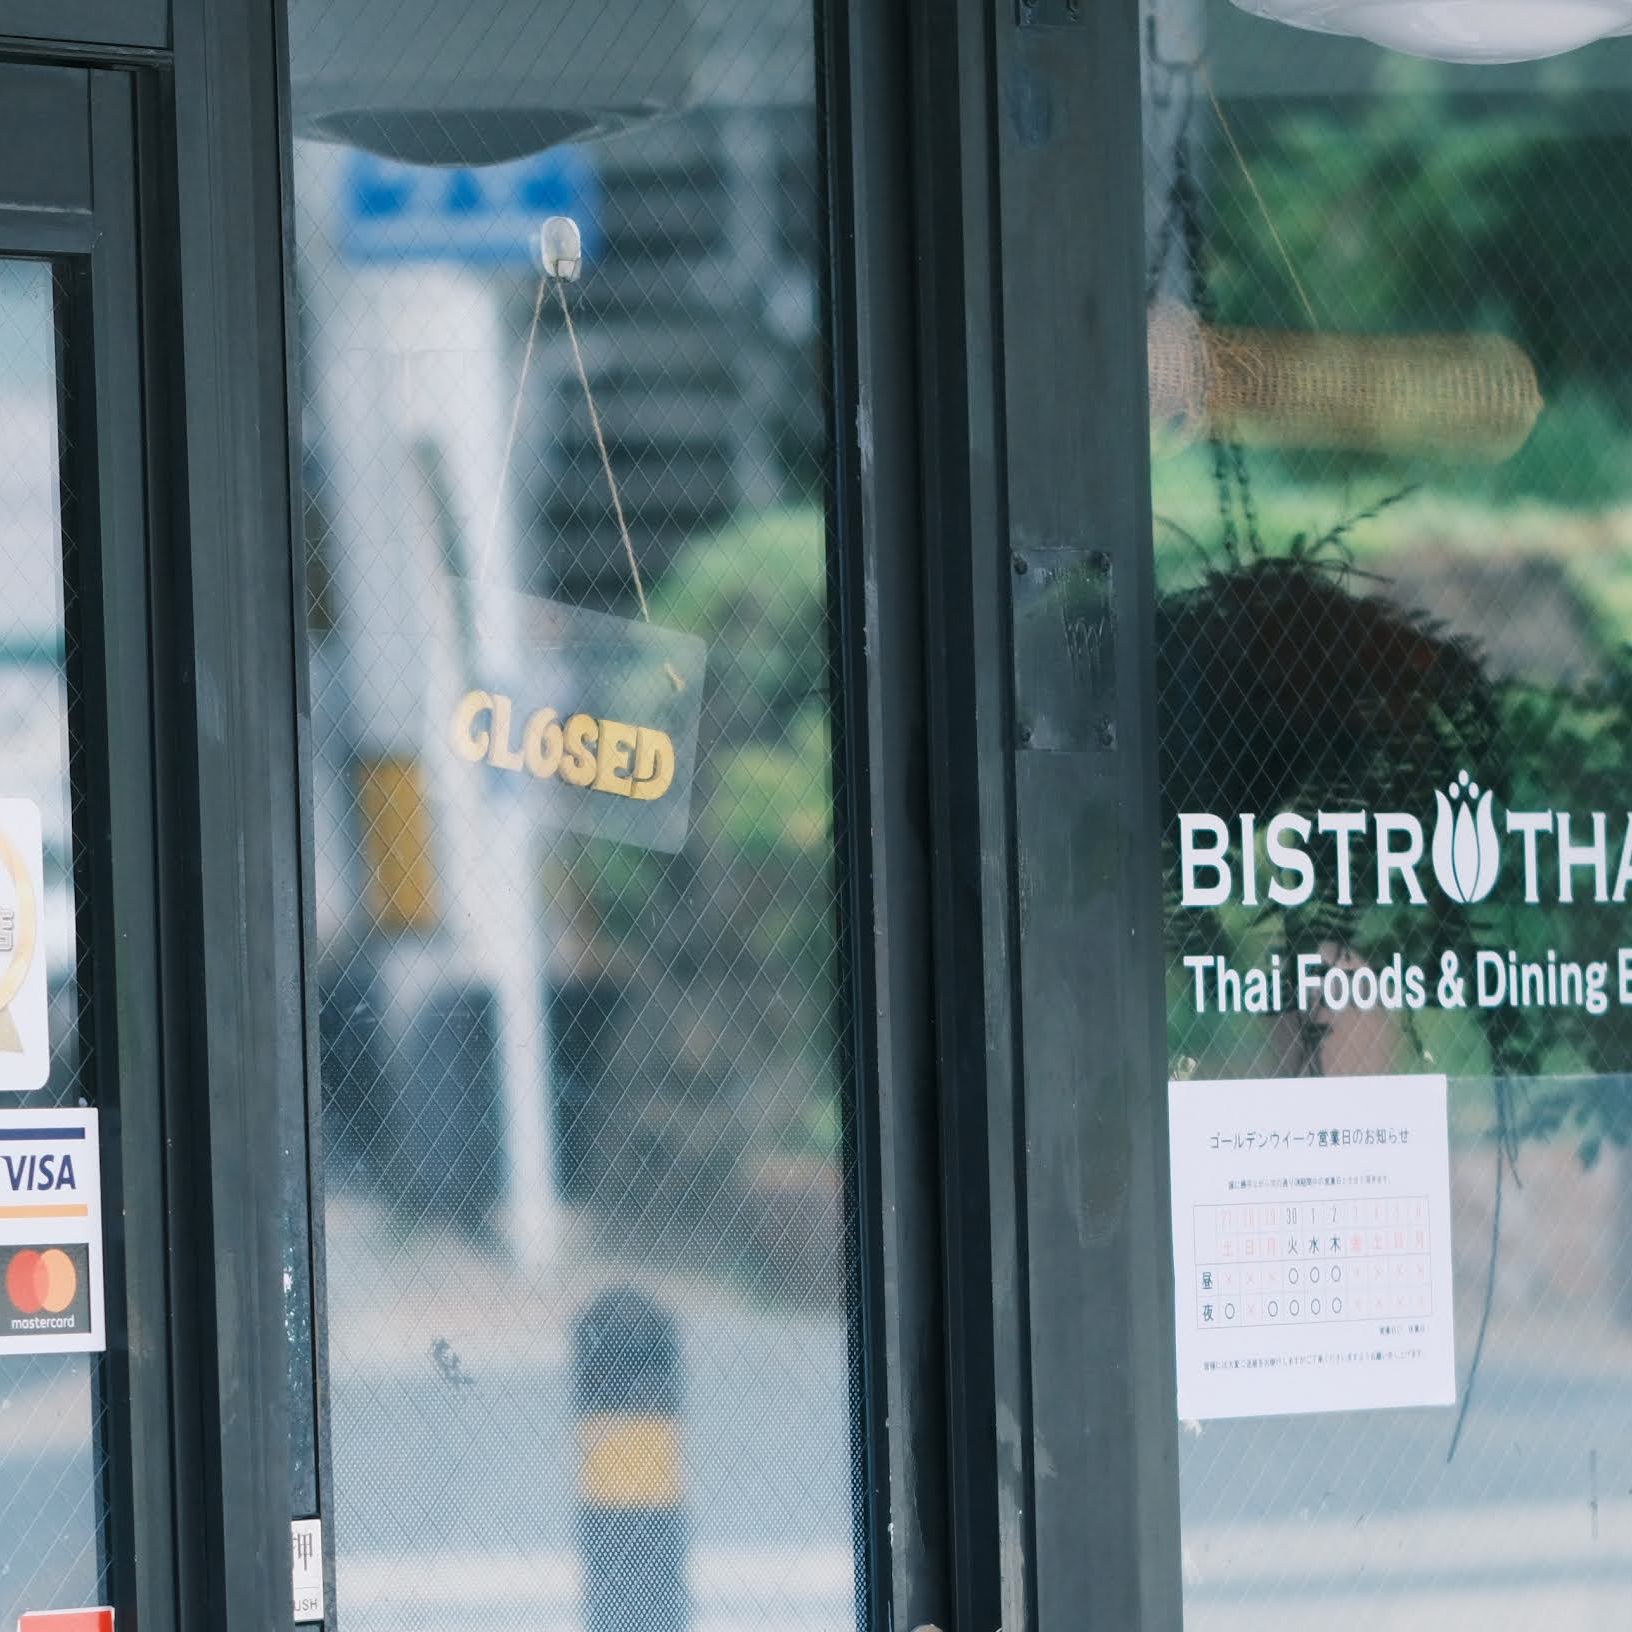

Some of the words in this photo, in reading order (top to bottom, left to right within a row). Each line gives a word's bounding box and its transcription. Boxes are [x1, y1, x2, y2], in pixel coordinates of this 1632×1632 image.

[452, 689, 676, 801] CLOSED
[1184, 954, 1281, 1013] Thai
[1297, 952, 1426, 1011] Foods
[1436, 949, 1467, 1009] &
[1477, 949, 1608, 1015] Dining
[0, 1154, 76, 1191] VISA
[1287, 1235, 1298, 1255] 火
[1309, 1235, 1319, 1255] 水
[1330, 1234, 1341, 1253] 木
[11, 1314, 75, 1330] mastercard
[1202, 1303, 1215, 1323] 夜
